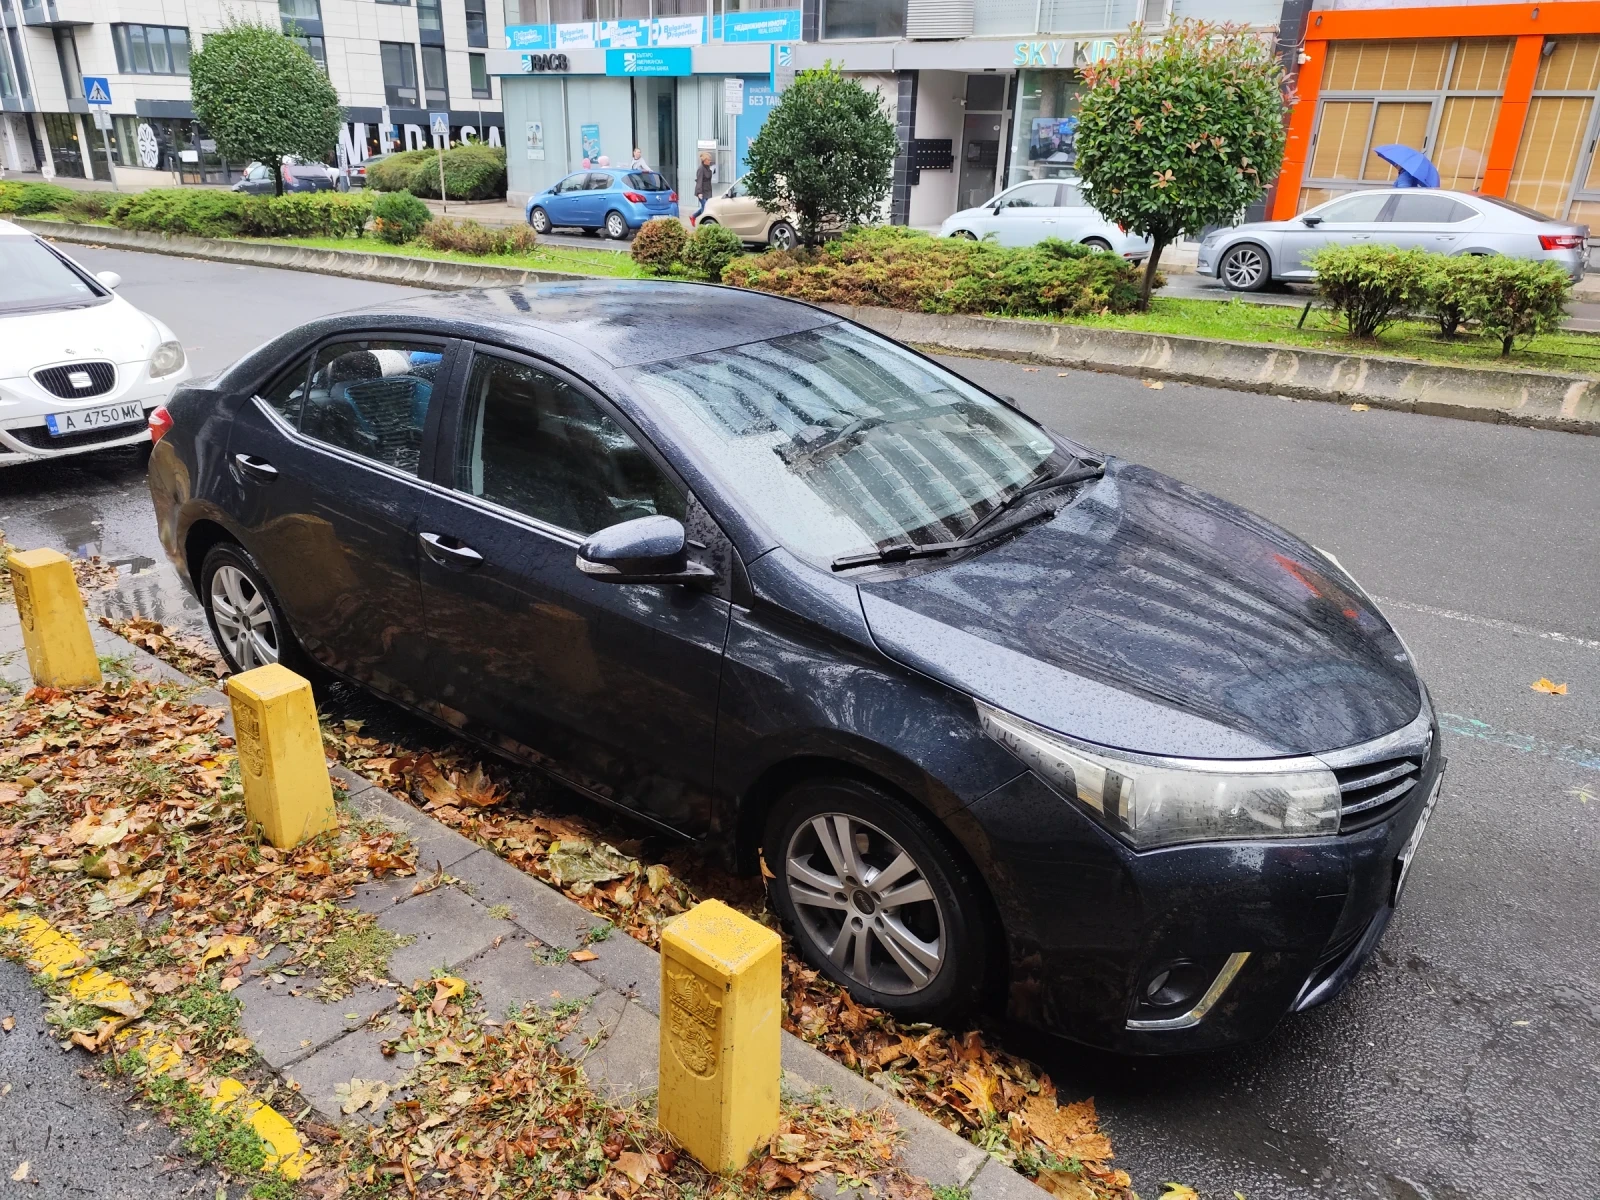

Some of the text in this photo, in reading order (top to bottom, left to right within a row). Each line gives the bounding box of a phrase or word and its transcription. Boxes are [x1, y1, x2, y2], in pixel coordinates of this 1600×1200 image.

[664, 22, 692, 33] Bulgarian
[560, 28, 584, 39] Bulgarian
[562, 33, 589, 44] Properties
[667, 28, 697, 39] Properties
[1013, 41, 1066, 66] SKY
[533, 53, 568, 72] BACB
[749, 95, 764, 106] БЕЗ
[66, 404, 140, 429] A 4750 MK
